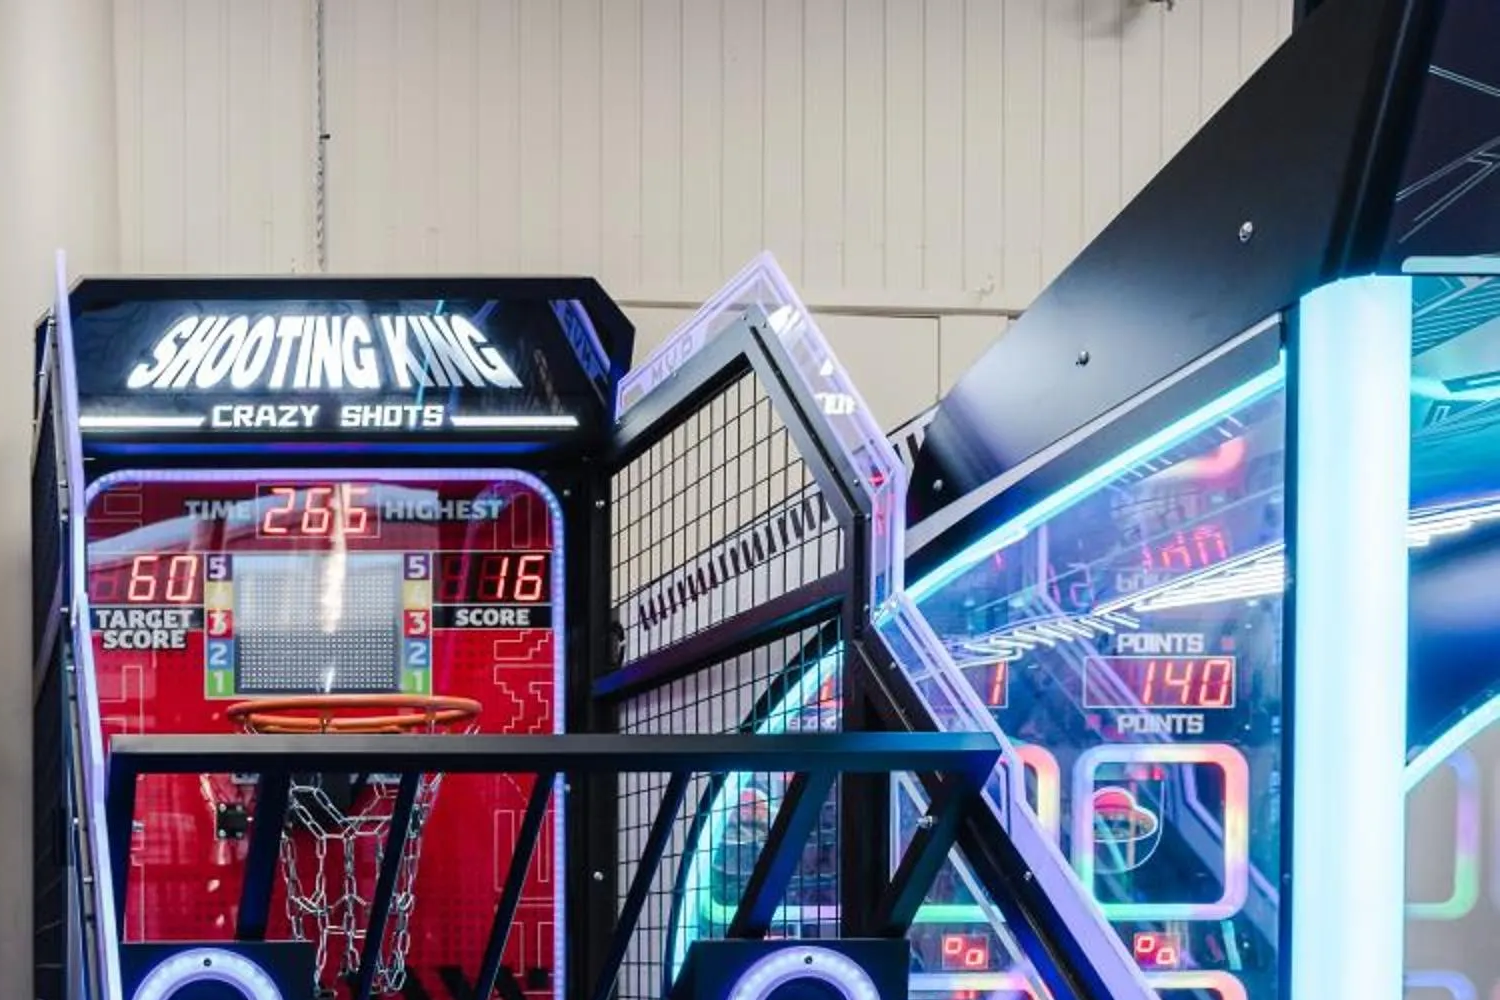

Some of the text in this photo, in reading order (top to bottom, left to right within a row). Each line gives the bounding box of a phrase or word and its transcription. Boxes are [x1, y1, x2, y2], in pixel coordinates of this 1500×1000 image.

[127, 314, 381, 389] SHOOTING
[380, 314, 523, 389] KING
[211, 404, 444, 428] CRAZY SHOTS
[184, 499, 503, 521] TIME HIGHEST
[127, 555, 198, 602] 60
[209, 556, 227, 580] 5
[408, 556, 426, 580] 5
[495, 555, 546, 602] 16
[98, 610, 194, 630] TARGET
[408, 612, 426, 635] 3
[454, 608, 530, 628] SCORE
[102, 630, 187, 650] SCORE
[1116, 633, 1206, 653] POINTS
[209, 641, 227, 665] 2
[408, 641, 426, 665] 2
[212, 670, 224, 693] 1
[411, 670, 423, 693] 1
[1141, 660, 1232, 706] 140
[1116, 714, 1206, 733] POINTS
